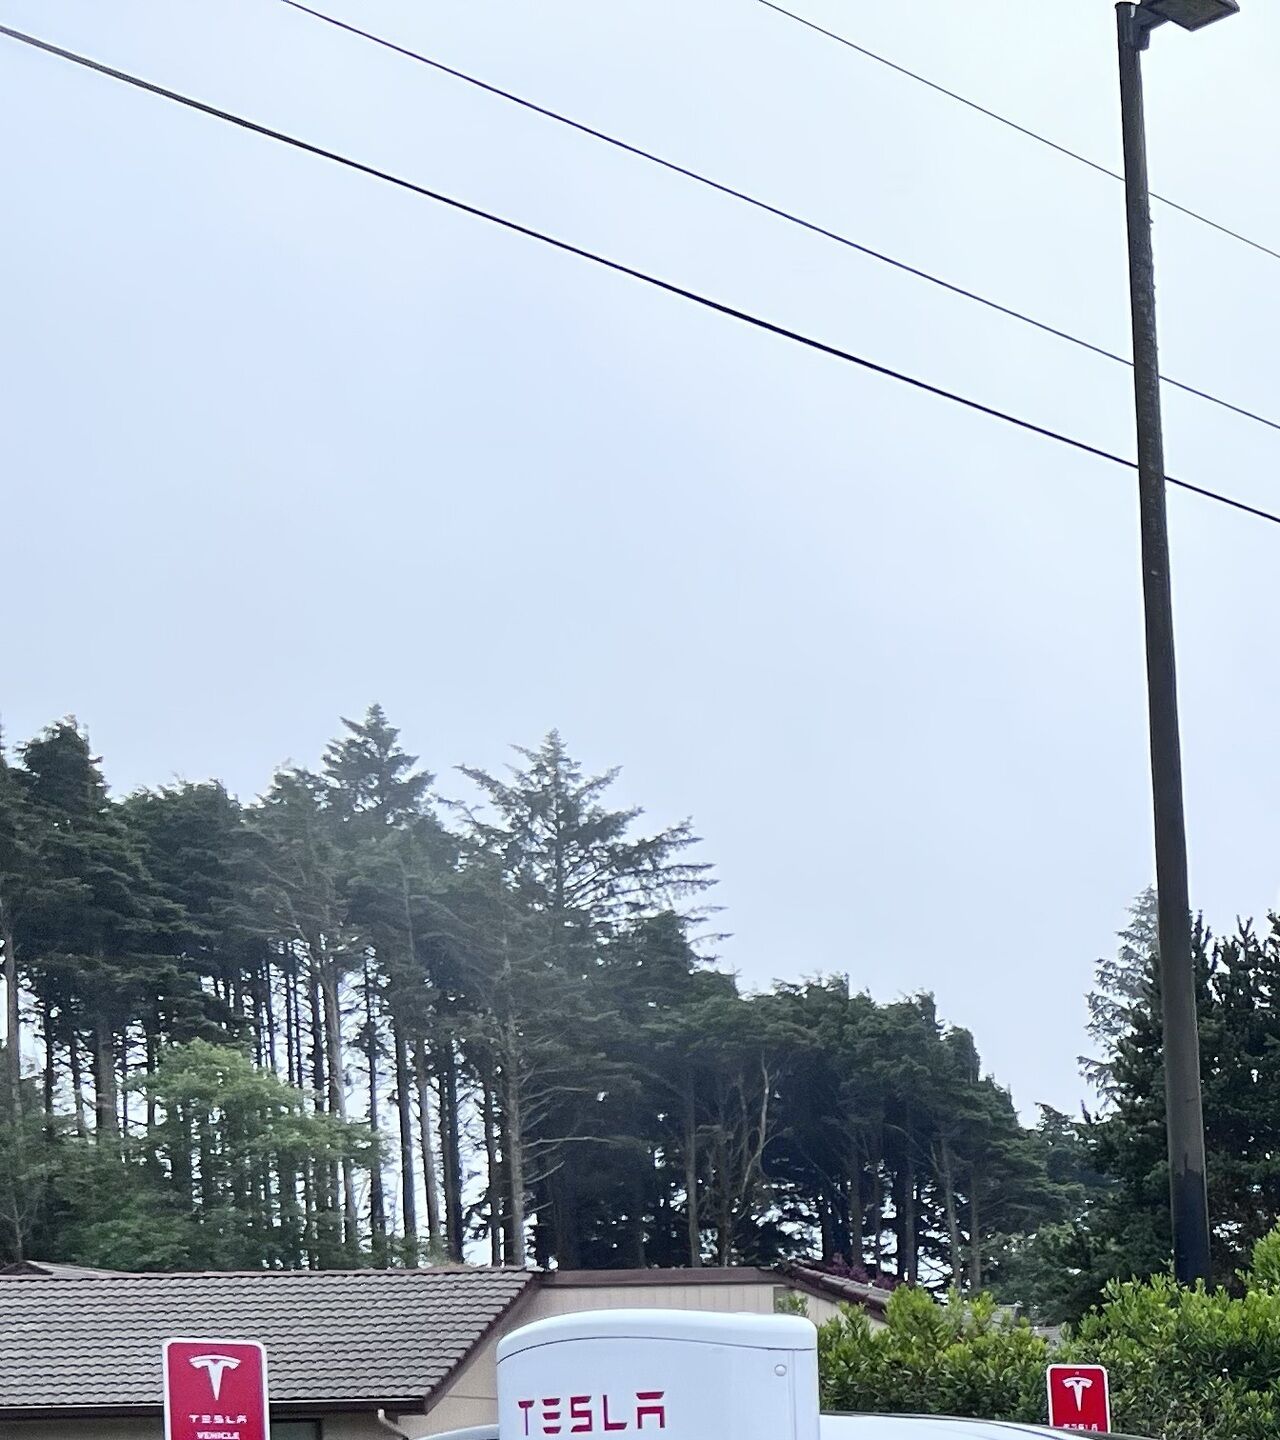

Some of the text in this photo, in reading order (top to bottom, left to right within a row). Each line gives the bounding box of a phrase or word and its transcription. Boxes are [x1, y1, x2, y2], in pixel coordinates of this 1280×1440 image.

[517, 1391, 666, 1436] TESLA
[188, 1414, 247, 1424] TESLA
[196, 1431, 240, 1440] VEHICLE
